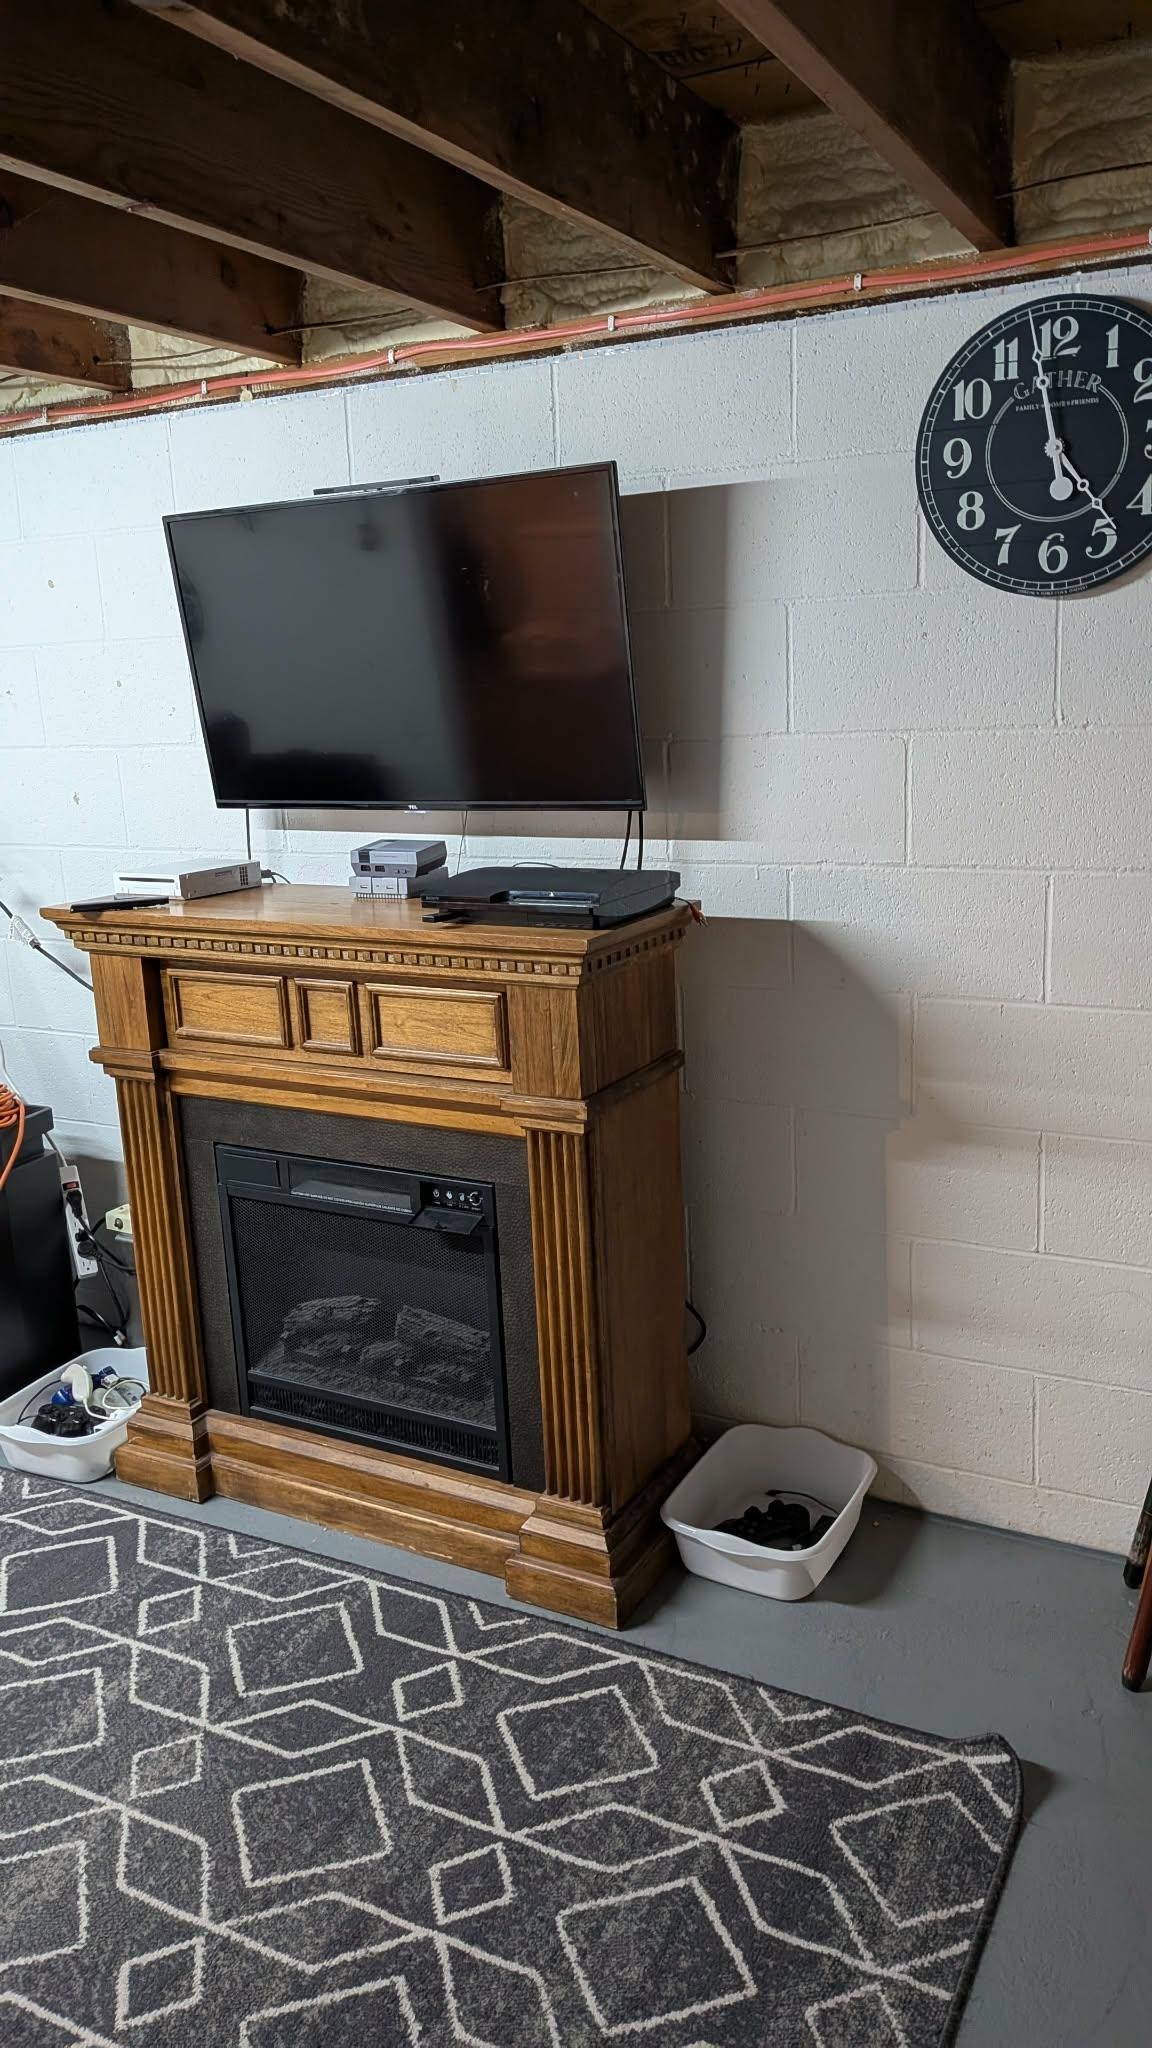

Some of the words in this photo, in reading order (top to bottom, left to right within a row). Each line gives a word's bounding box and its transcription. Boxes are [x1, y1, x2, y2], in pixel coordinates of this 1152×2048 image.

[993, 337, 1020, 382] 11
[1039, 316, 1082, 361] 12
[1105, 324, 1120, 369] 1
[952, 378, 992, 421] 10
[1133, 357, 1152, 403] 2
[943, 437, 972, 479] 9
[956, 491, 985, 531] 8
[1126, 474, 1152, 516] 4
[994, 523, 1022, 566] 7
[1037, 532, 1068, 574] 6
[1085, 518, 1118, 559] 5
